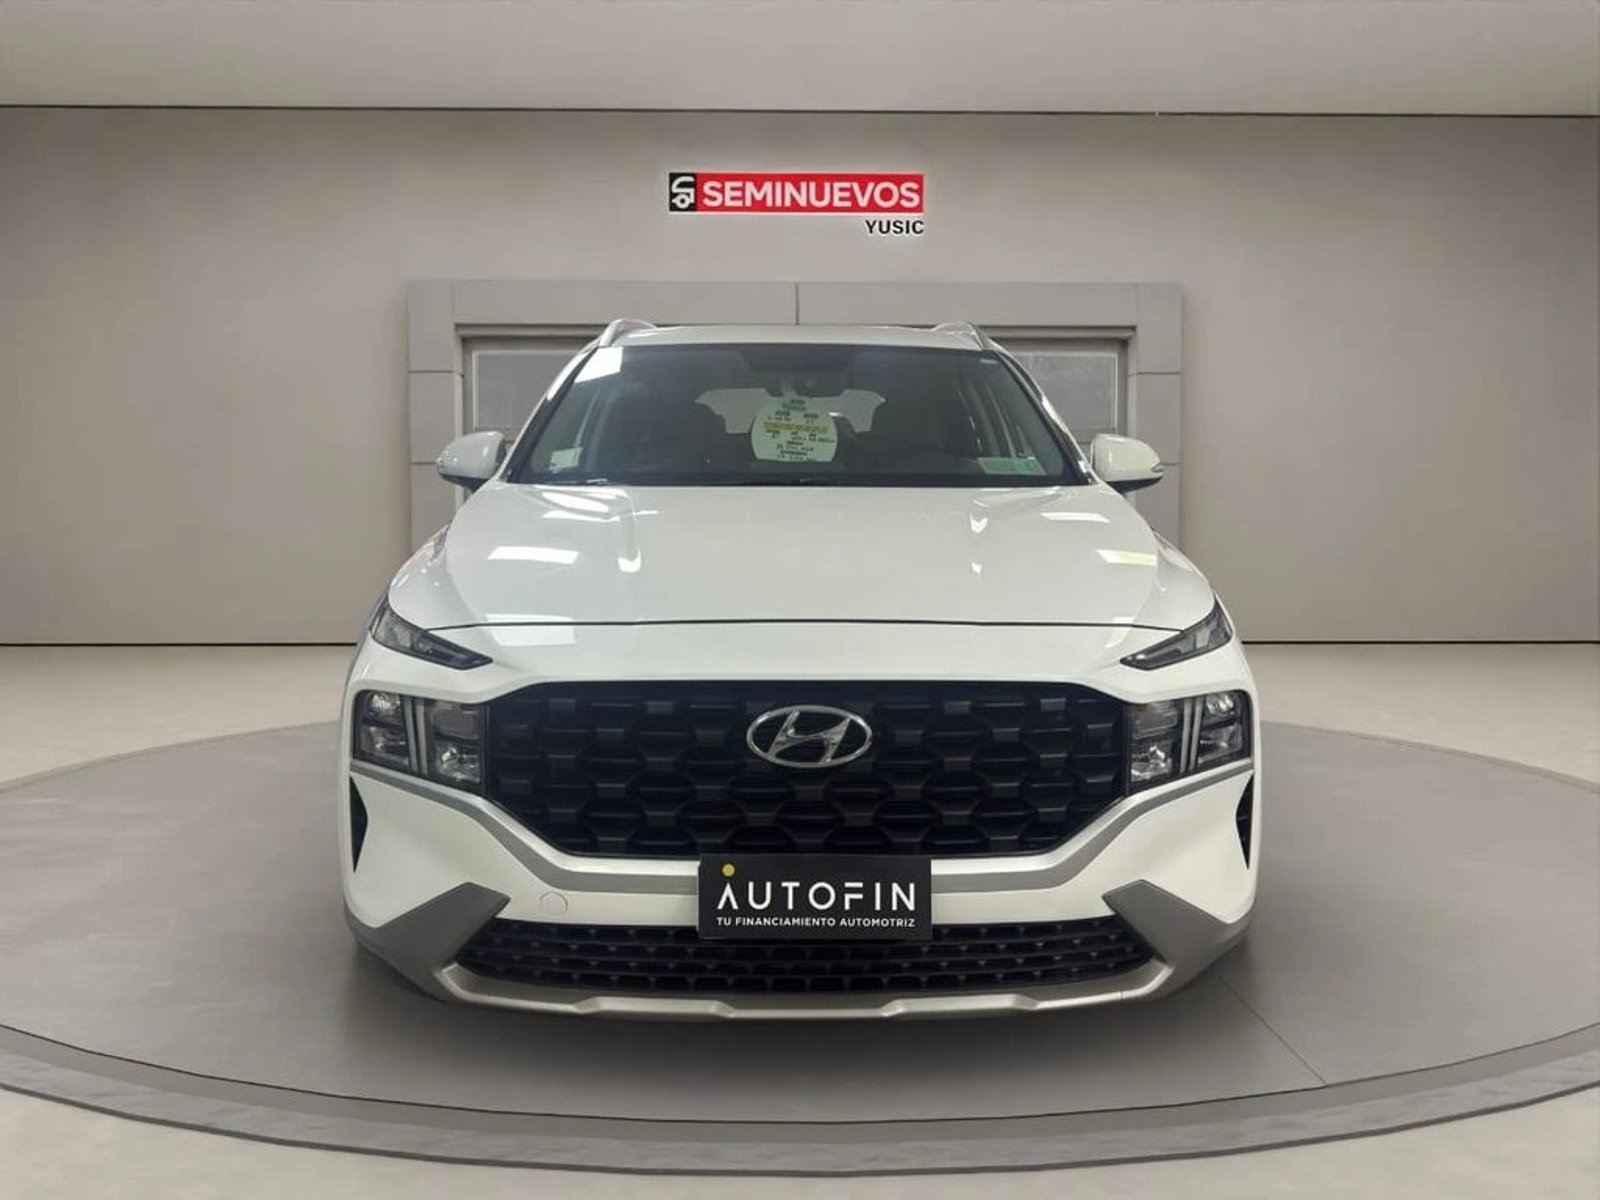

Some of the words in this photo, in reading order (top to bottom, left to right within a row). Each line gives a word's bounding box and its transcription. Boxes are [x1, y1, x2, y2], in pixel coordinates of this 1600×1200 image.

[702, 180, 921, 208] SEMINUEVOS
[865, 219, 925, 235] YUSIC
[716, 881, 915, 911] AUTOFIN
[716, 916, 732, 926] TU
[735, 916, 836, 927] FINANCIAMIENTO
[839, 917, 916, 928] AUTOMOTRIZ
